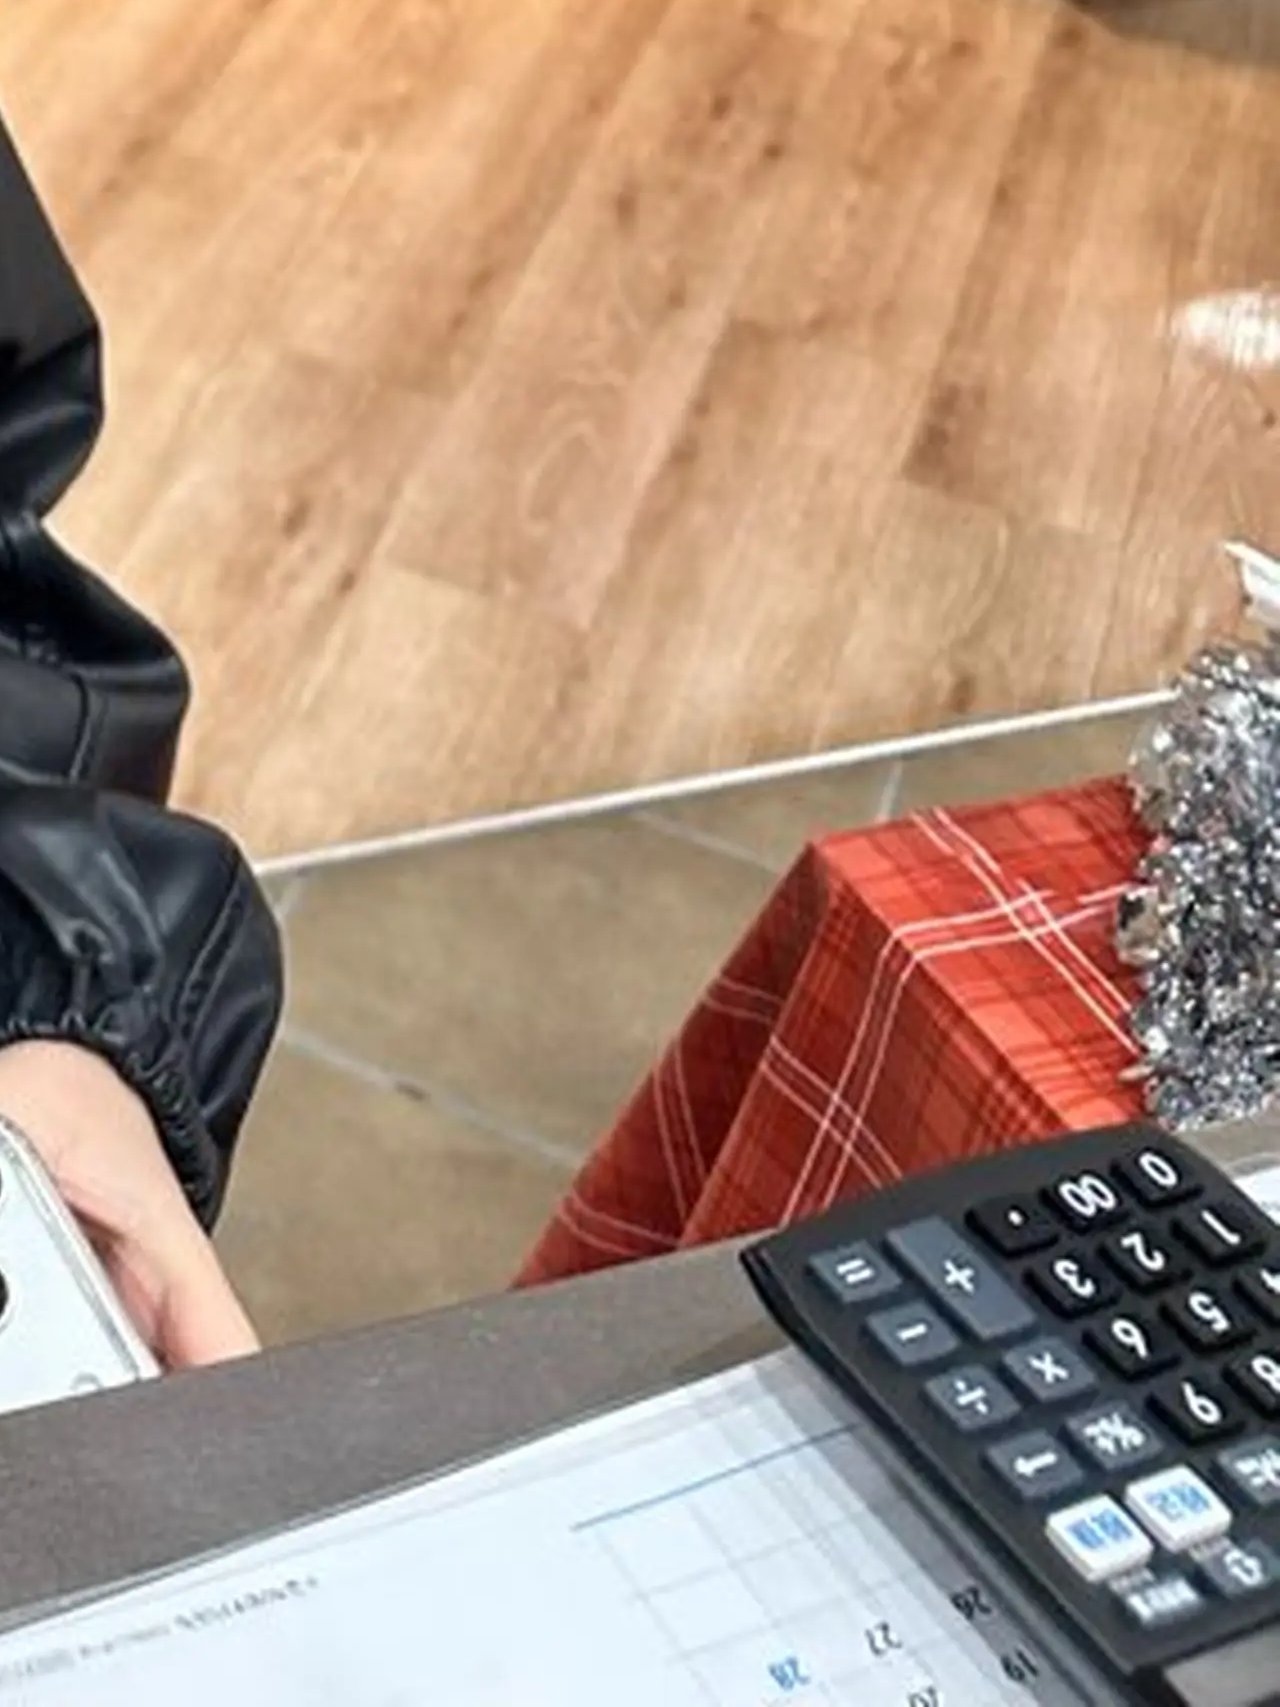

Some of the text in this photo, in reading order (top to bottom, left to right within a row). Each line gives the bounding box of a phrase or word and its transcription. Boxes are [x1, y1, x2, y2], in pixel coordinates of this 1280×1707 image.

[1140, 1152, 1178, 1187] 0
[1059, 1175, 1116, 1217] 00
[1201, 1210, 1240, 1245] 1
[1120, 1233, 1165, 1271] 2
[1053, 1260, 1095, 1298] 3
[1190, 1292, 1230, 1332] 5
[1111, 1318, 1148, 1359] 6
[1182, 1381, 1222, 1424] 9
[950, 1586, 991, 1620] 26
[865, 1620, 902, 1656] 27
[768, 1656, 811, 1691] 28
[1000, 1647, 1040, 1684] 19
